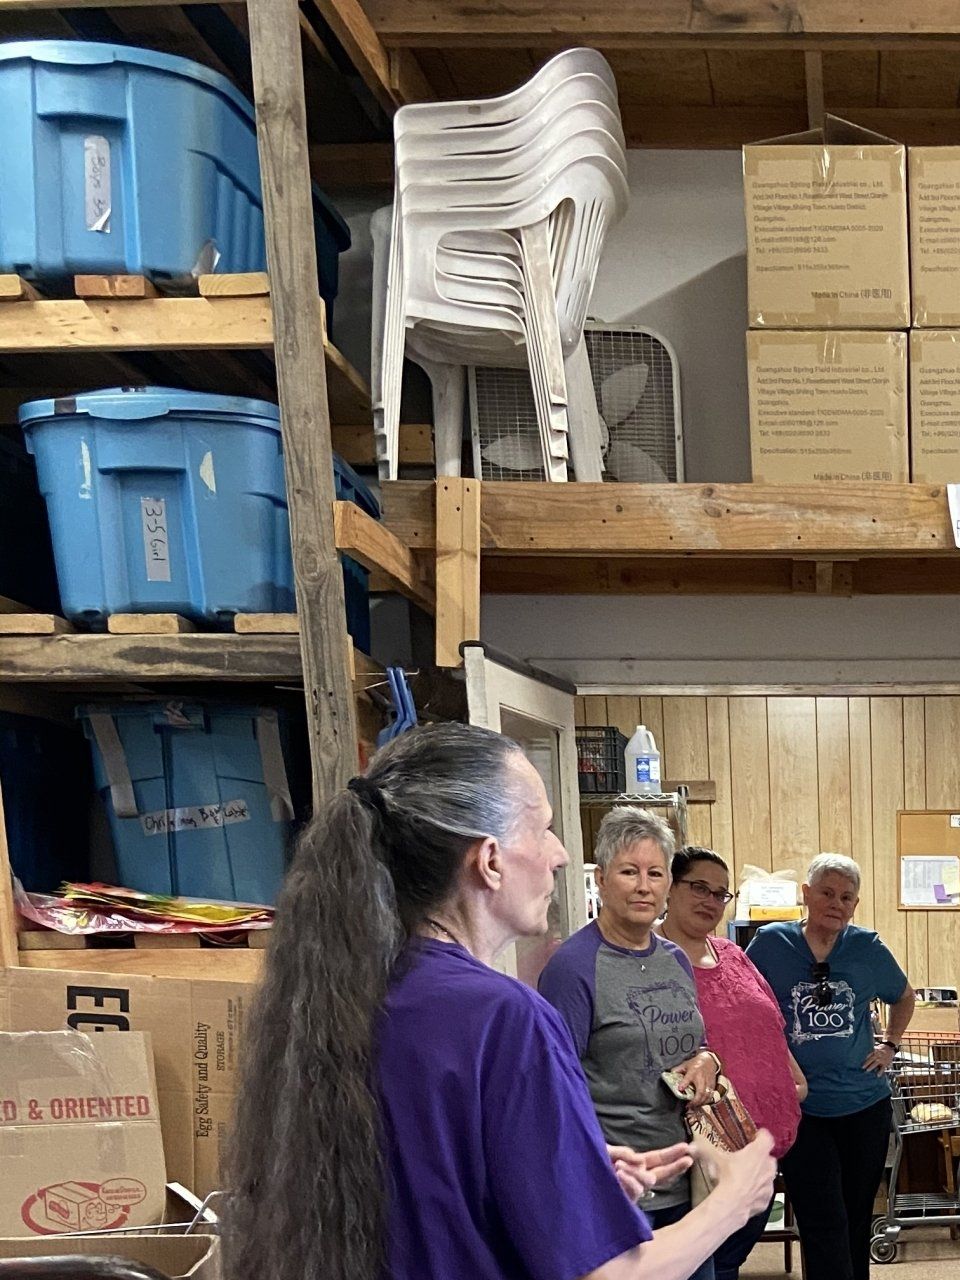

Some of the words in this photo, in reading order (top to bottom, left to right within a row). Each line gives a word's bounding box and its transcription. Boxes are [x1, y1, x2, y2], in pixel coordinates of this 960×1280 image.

[146, 506, 166, 533] 3-5
[150, 538, 167, 561] Girl
[642, 1005, 695, 1032] Power
[808, 1012, 844, 1028] 100
[194, 1022, 211, 1060] Quality
[216, 1031, 225, 1071] STORAGE
[659, 1033, 695, 1056] 100
[194, 1062, 209, 1081] and
[28, 1098, 43, 1121] &
[50, 1095, 150, 1120] ORIENTED
[195, 1083, 212, 1116] Safety
[196, 1118, 213, 1138] Egg
